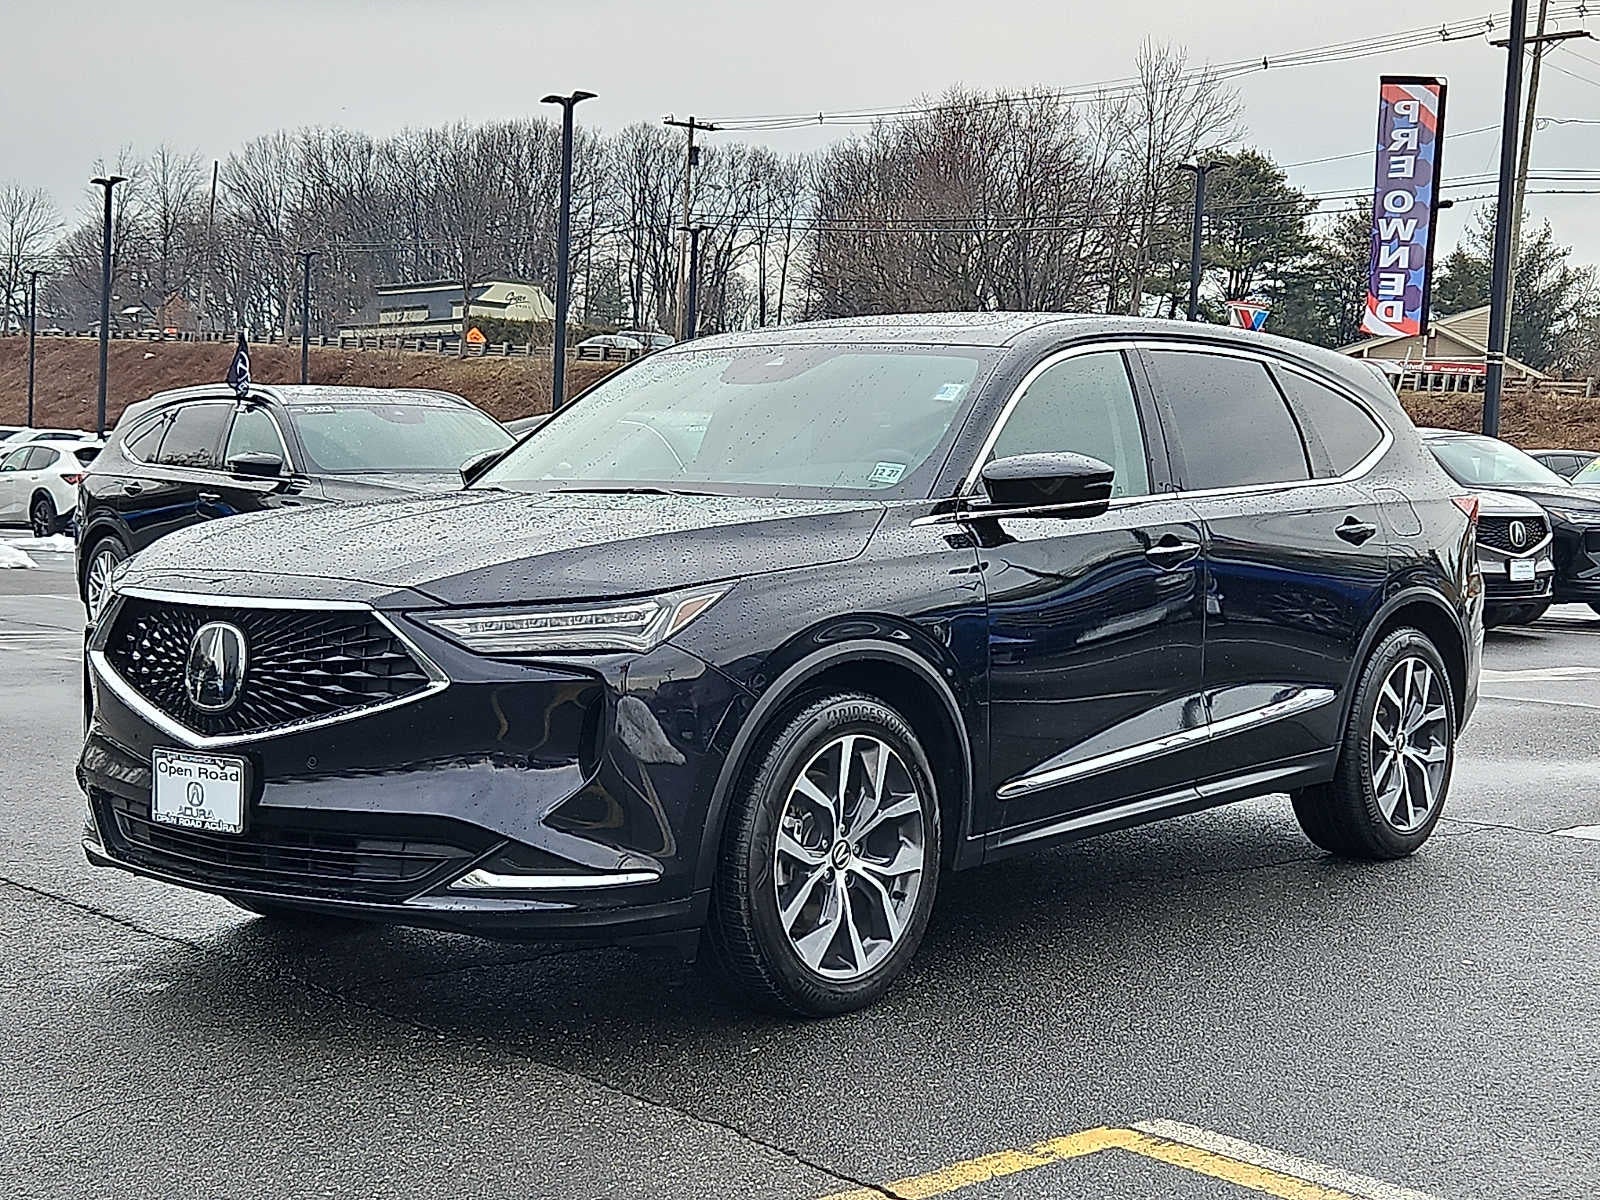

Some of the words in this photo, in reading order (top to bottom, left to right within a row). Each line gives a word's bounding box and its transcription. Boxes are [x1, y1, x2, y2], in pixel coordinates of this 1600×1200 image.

[158, 761, 193, 778] Open
[198, 766, 239, 782] Road
[177, 805, 216, 820] ACURA
[178, 818, 203, 828] ROAD
[203, 821, 236, 832] ACURA
